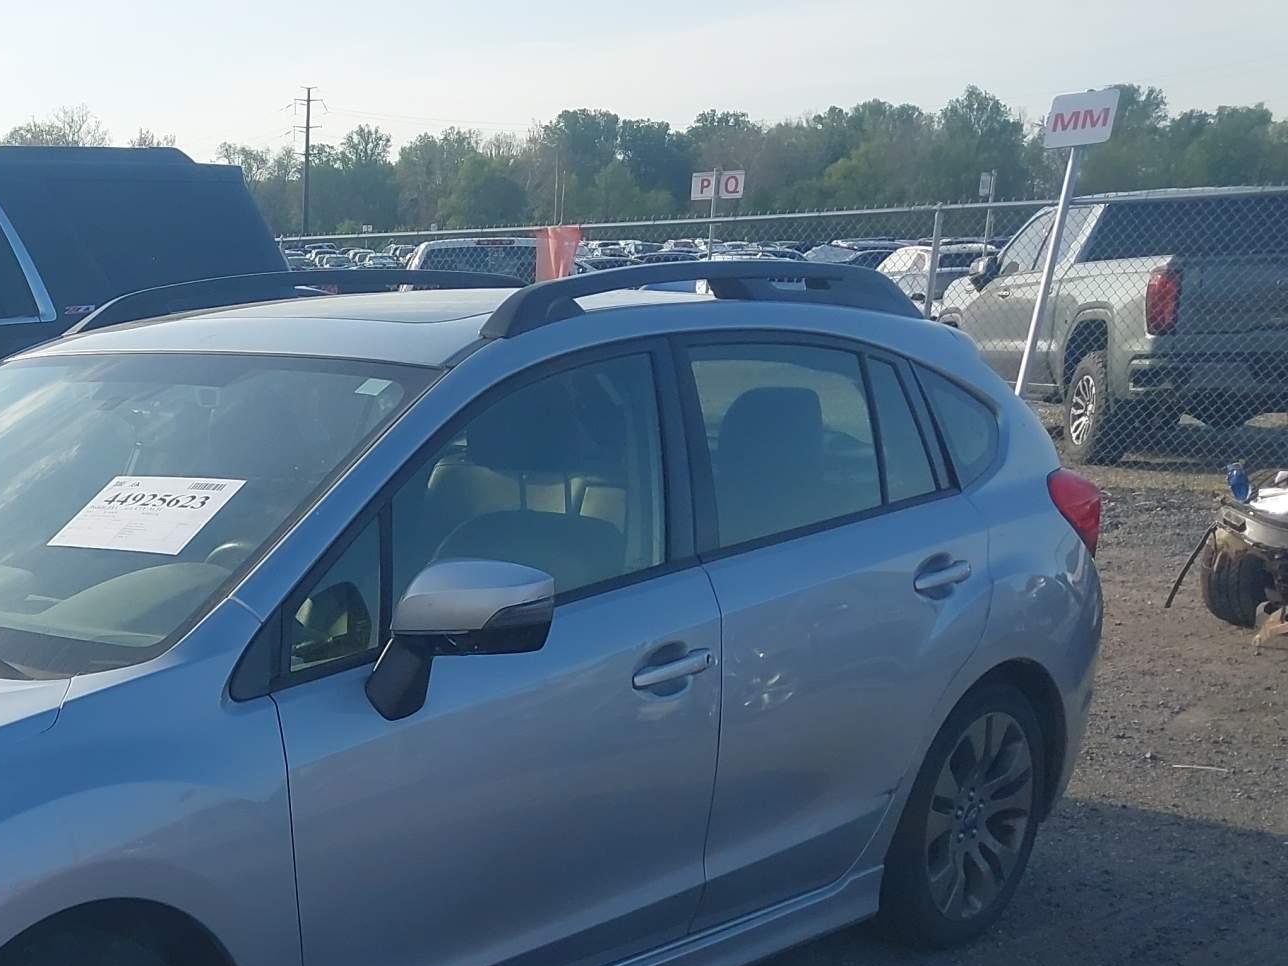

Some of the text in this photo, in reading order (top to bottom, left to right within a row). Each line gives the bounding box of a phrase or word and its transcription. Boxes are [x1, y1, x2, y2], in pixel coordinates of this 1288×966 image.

[1052, 107, 1111, 133] MM
[700, 178, 712, 195] P
[724, 175, 740, 194] Q
[103, 492, 211, 510] 44925623
